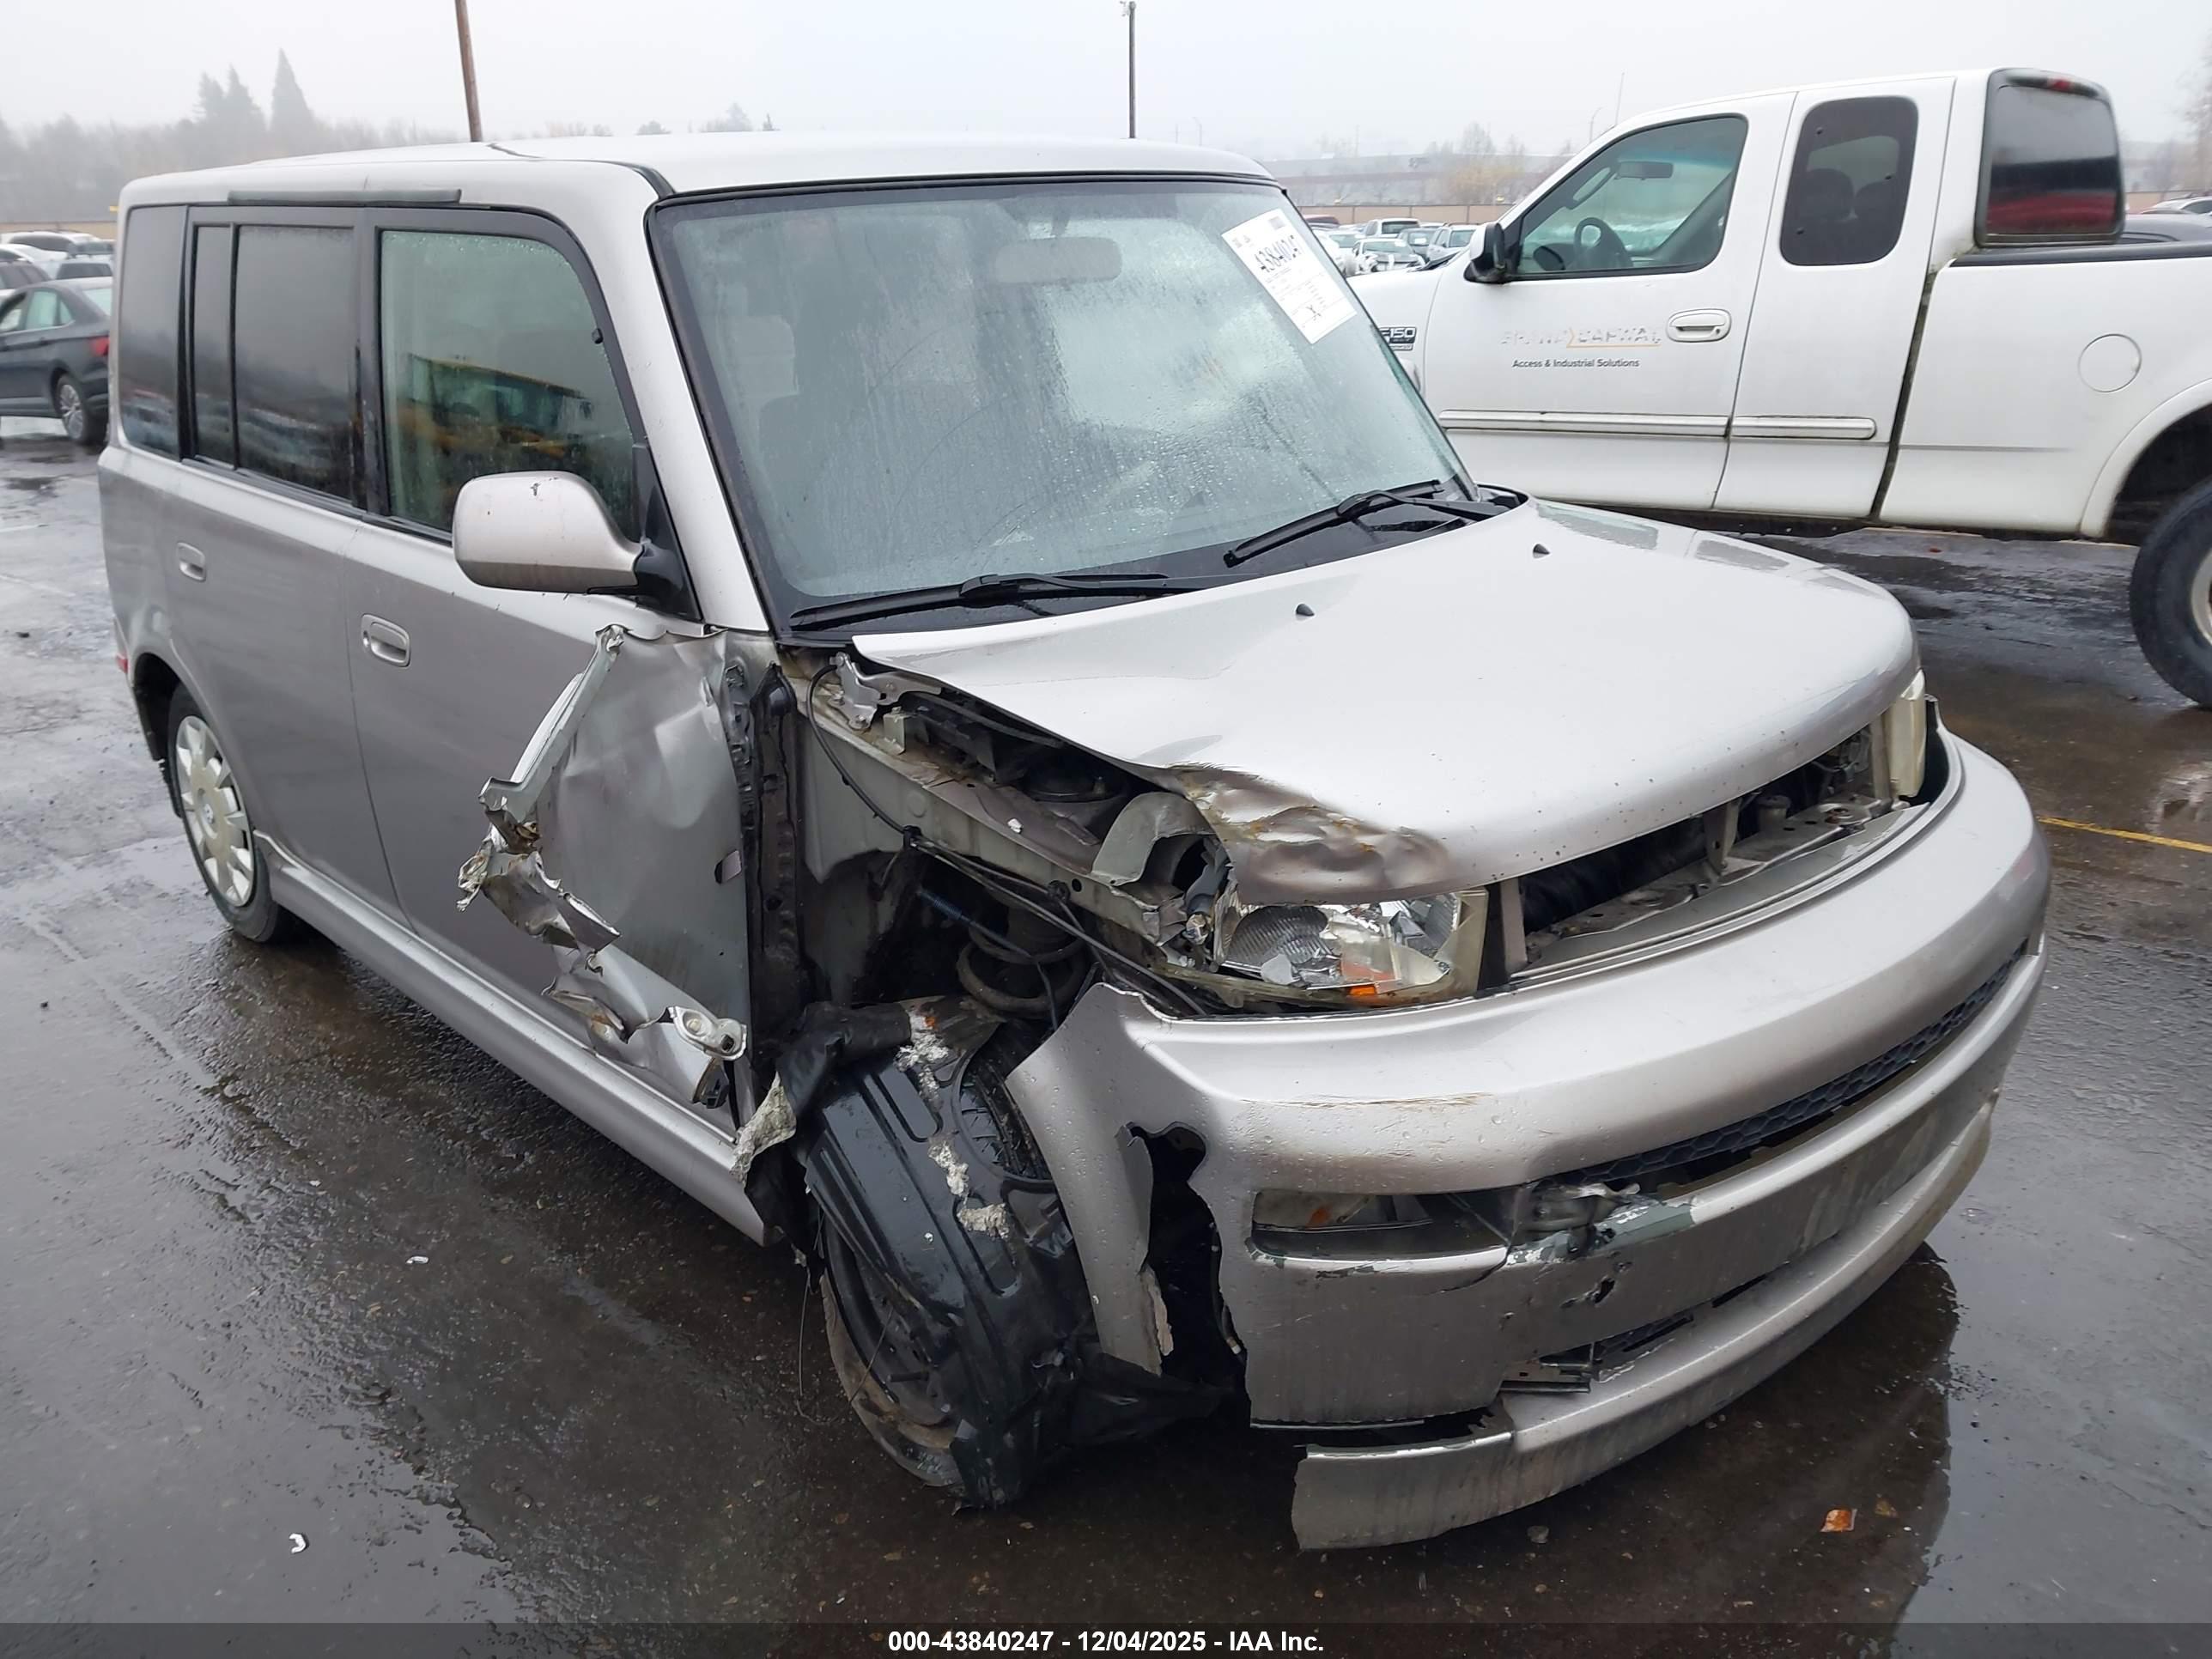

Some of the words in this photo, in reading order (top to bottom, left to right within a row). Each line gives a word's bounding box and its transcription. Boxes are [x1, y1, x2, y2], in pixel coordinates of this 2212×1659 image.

[1544, 359, 1551, 368] &
[1553, 359, 1595, 368] Industrial
[1597, 358, 1639, 368] Solutions
